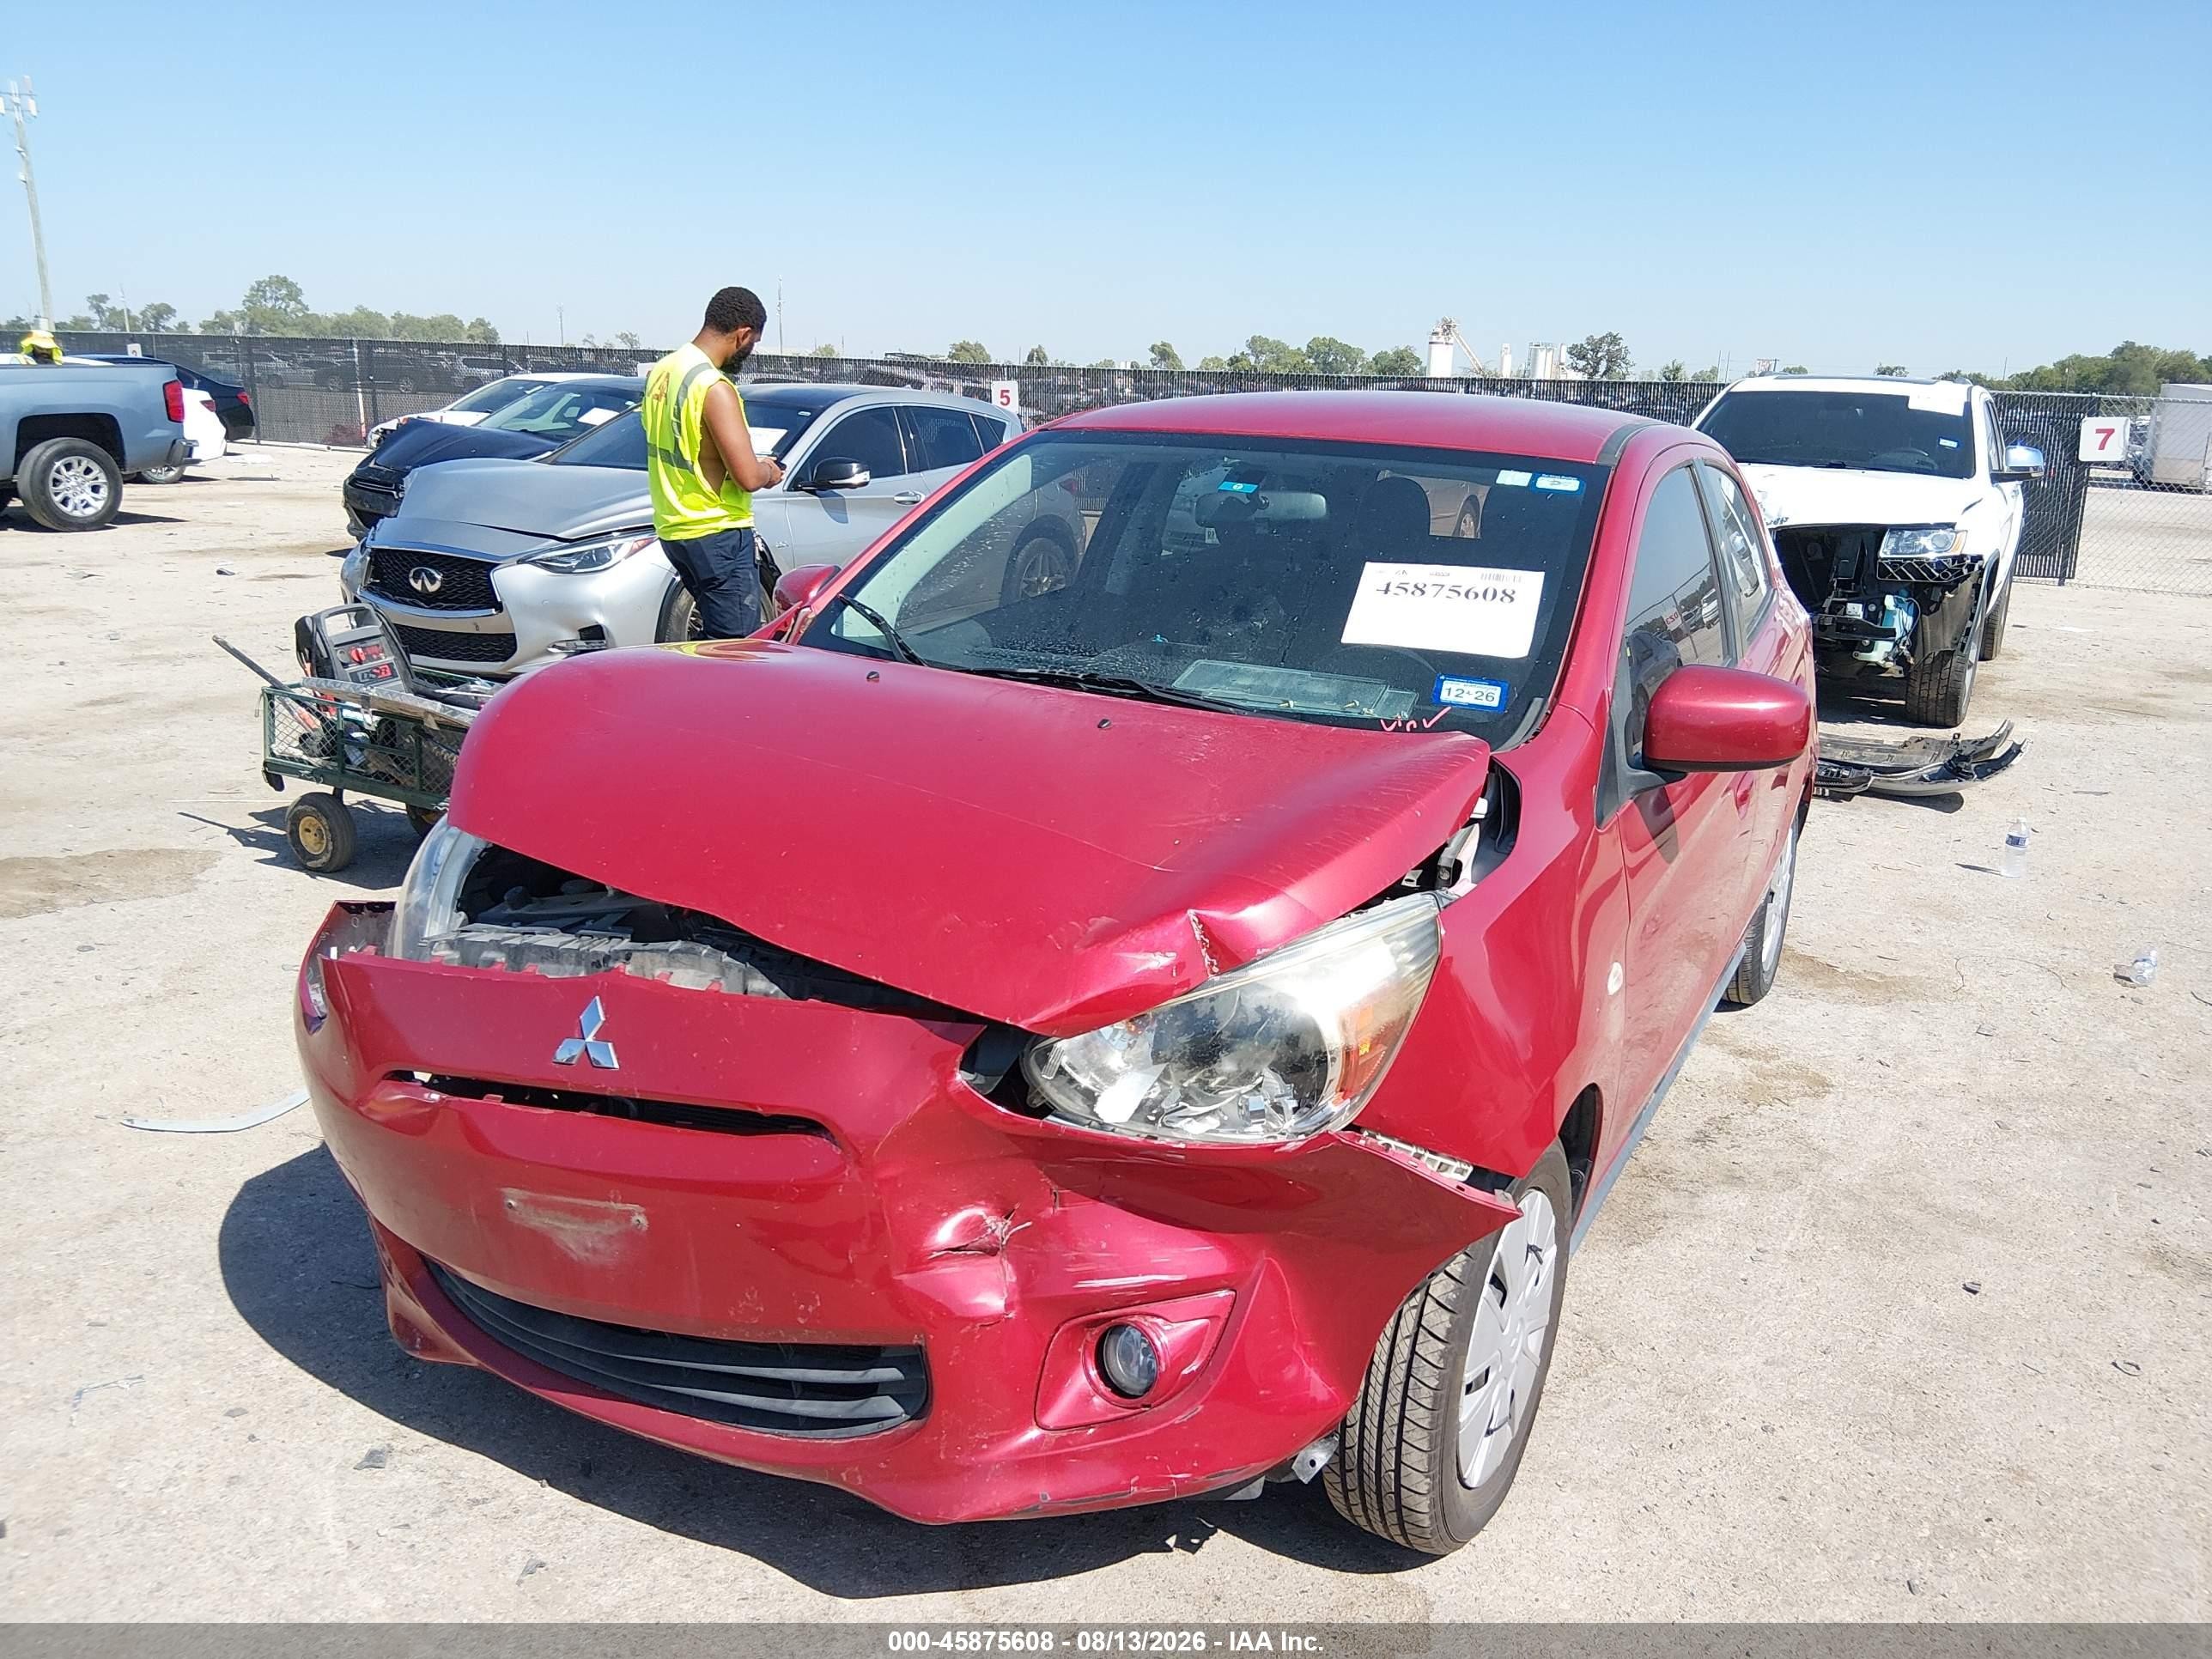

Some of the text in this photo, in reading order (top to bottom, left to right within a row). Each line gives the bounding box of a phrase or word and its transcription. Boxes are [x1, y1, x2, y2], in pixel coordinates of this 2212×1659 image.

[1000, 389, 1011, 406] 5
[2094, 428, 2116, 451] 7
[1376, 581, 1516, 604] 45875608
